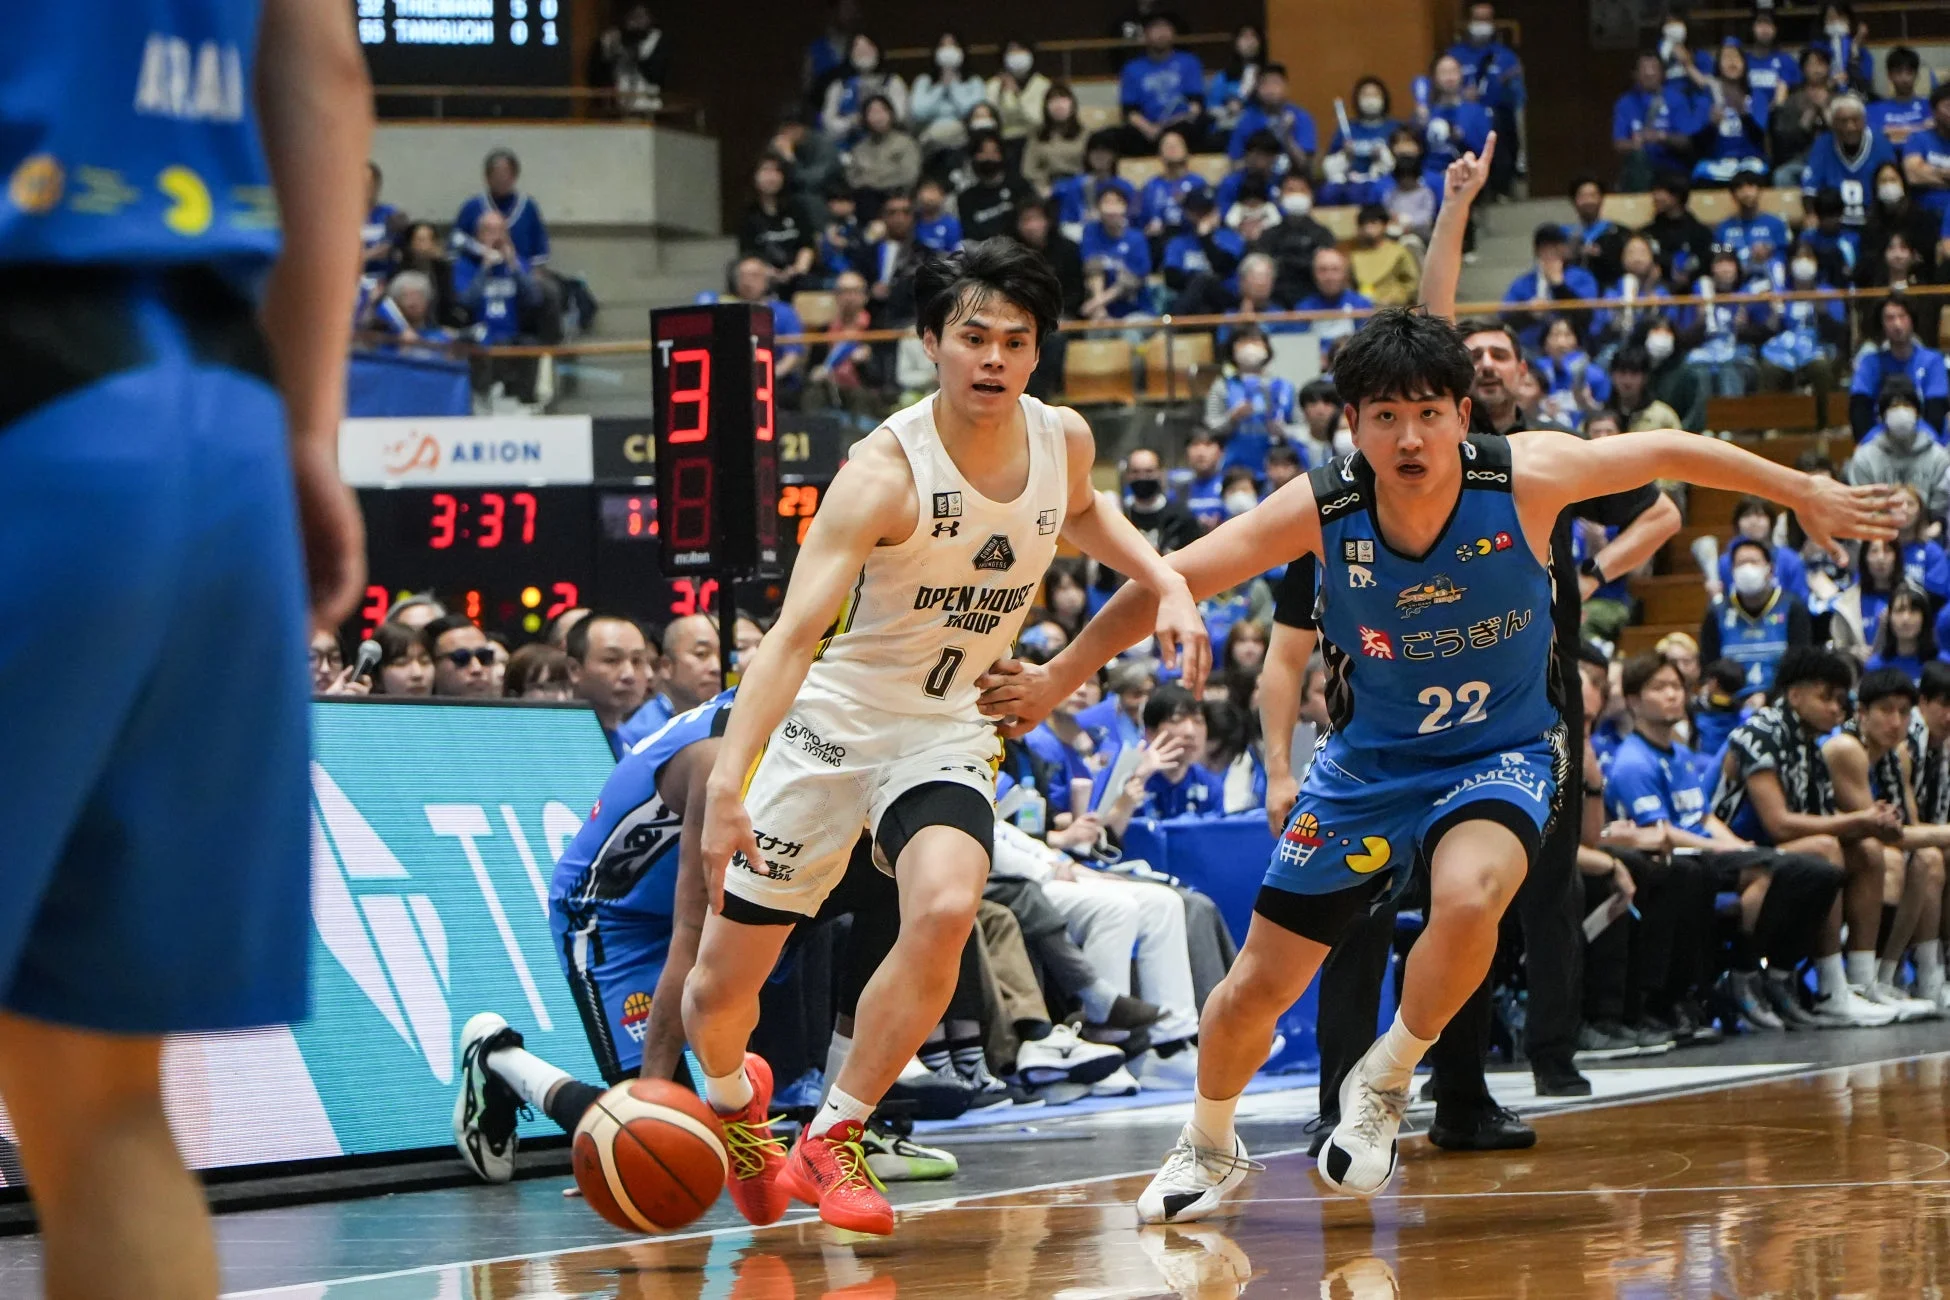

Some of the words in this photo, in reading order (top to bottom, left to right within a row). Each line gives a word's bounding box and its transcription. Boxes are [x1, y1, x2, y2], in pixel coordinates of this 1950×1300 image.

[510, 20, 528, 46] 0
[541, 20, 559, 46] 1
[668, 349, 711, 444] 3
[452, 441, 542, 463] ARION
[780, 432, 810, 461] 21
[429, 492, 538, 549] 3:37
[913, 585, 976, 613] OPEN
[974, 582, 1035, 614] HOUSE
[942, 612, 1001, 635] GROUP
[1402, 609, 1532, 660] ごうぎん
[922, 645, 966, 700] 0
[1417, 680, 1492, 734] 22
[799, 725, 846, 759] RYOMO
[801, 740, 842, 769] SYSTEMS
